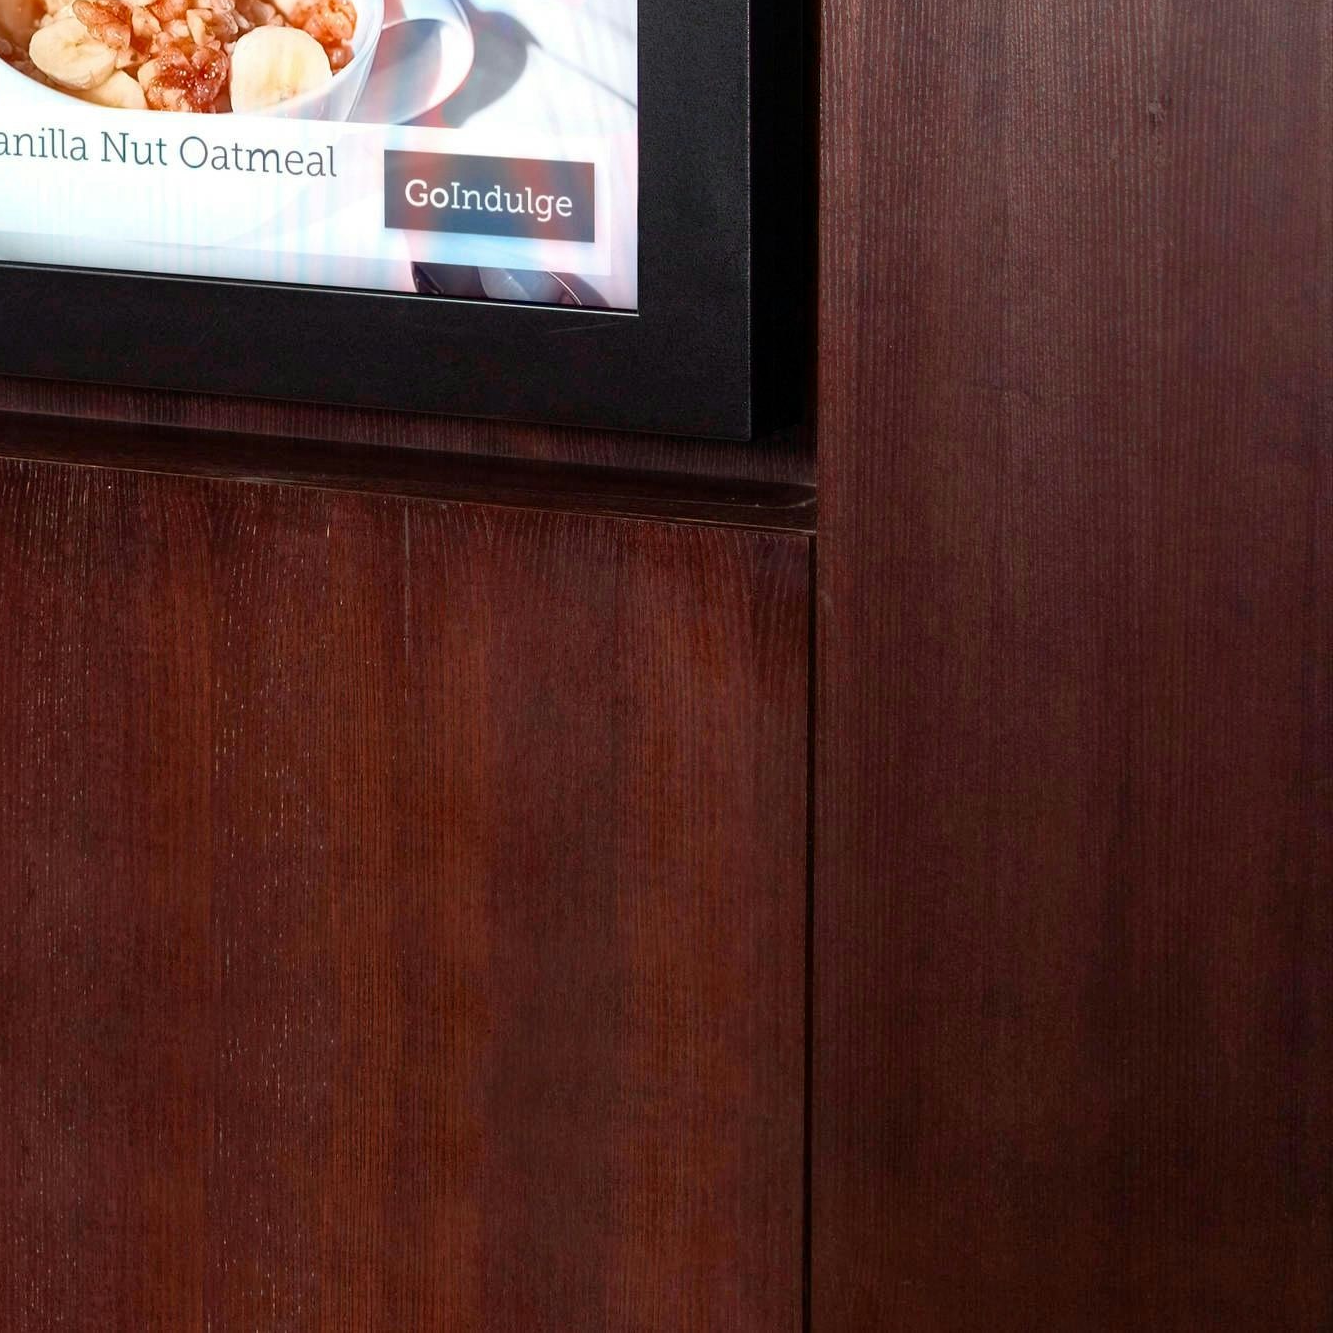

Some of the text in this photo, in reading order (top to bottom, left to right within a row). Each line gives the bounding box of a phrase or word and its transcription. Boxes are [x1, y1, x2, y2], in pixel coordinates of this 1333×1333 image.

[101, 130, 169, 168] Nut
[179, 135, 339, 180] Oatmeal
[403, 177, 574, 221] GoIndulge
